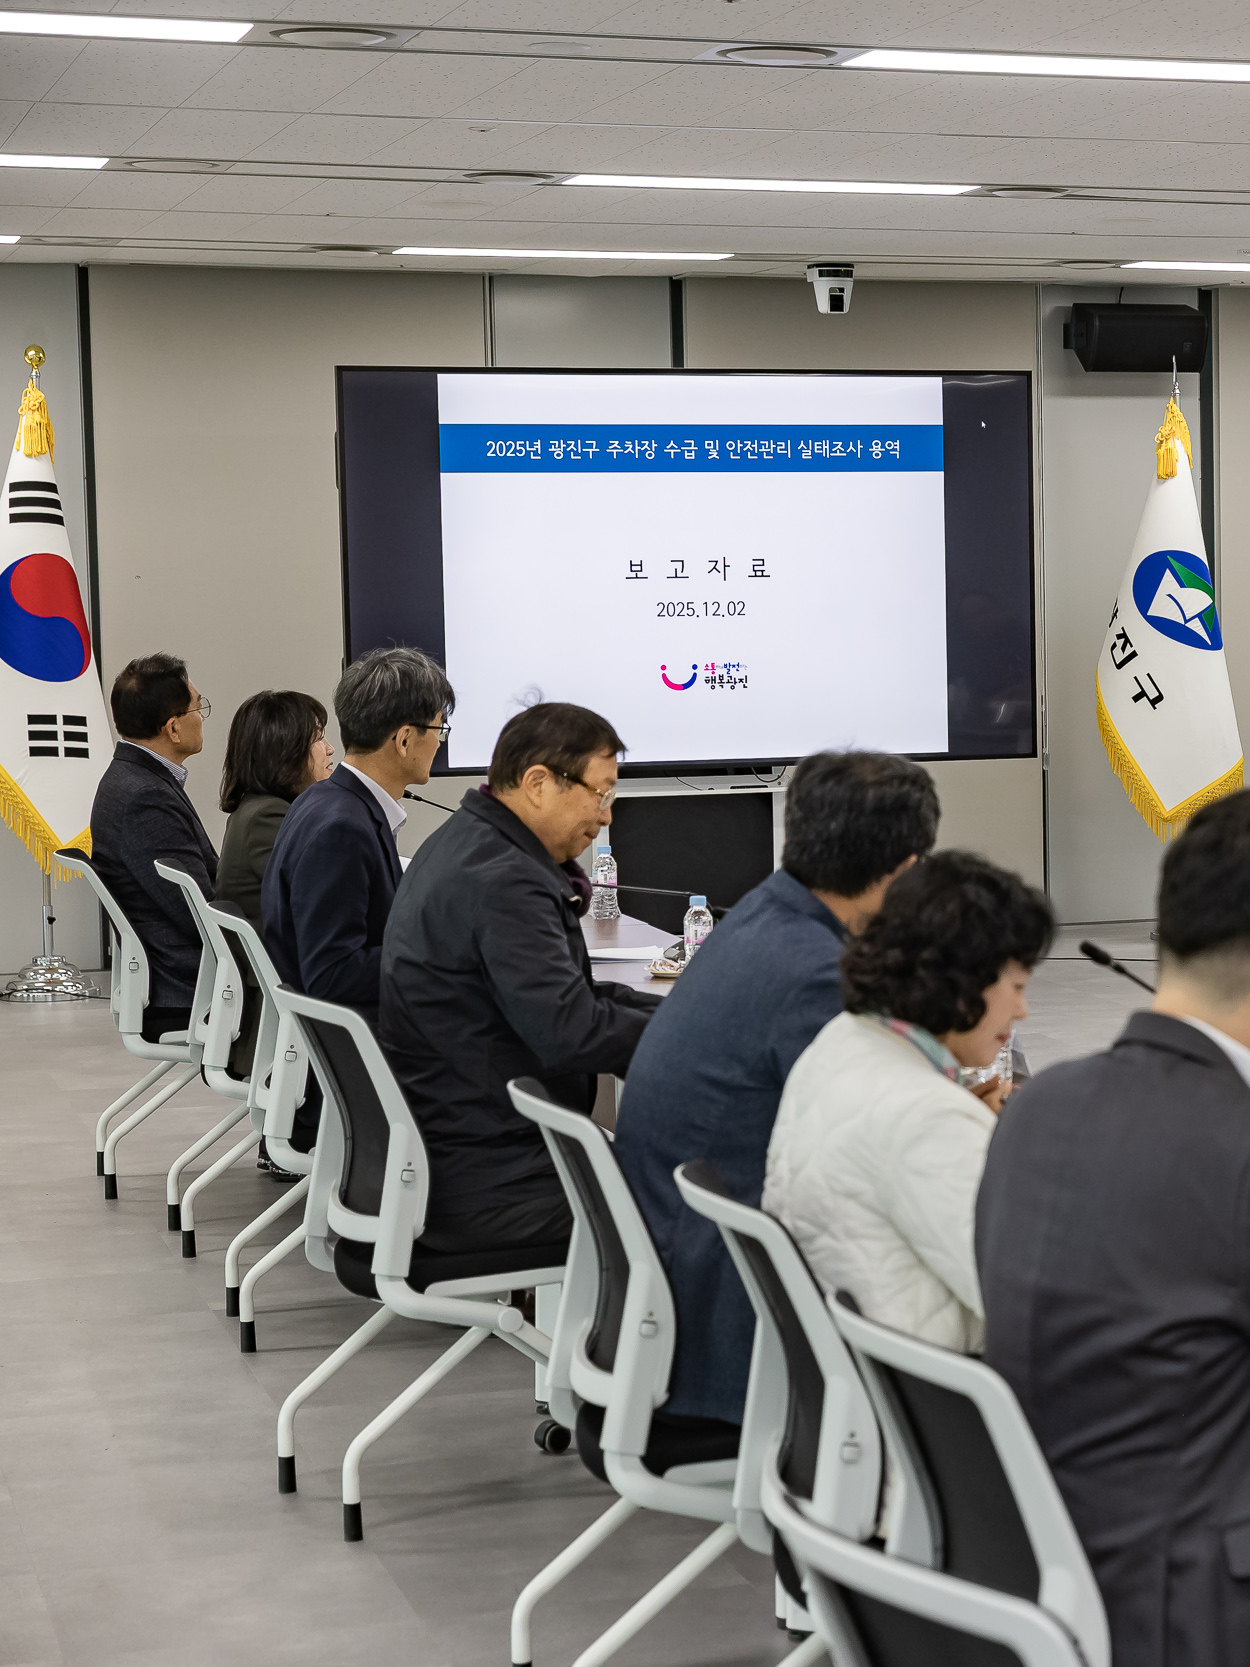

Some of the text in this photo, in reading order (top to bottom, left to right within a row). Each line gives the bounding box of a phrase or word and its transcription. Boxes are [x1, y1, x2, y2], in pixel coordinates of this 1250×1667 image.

[486, 438, 901, 460] 2025년 광진구 주차장 수급 및 안전관리 실태조사 용역
[656, 600, 746, 618] 2025.12.02
[704, 673, 748, 690] 행복광진
